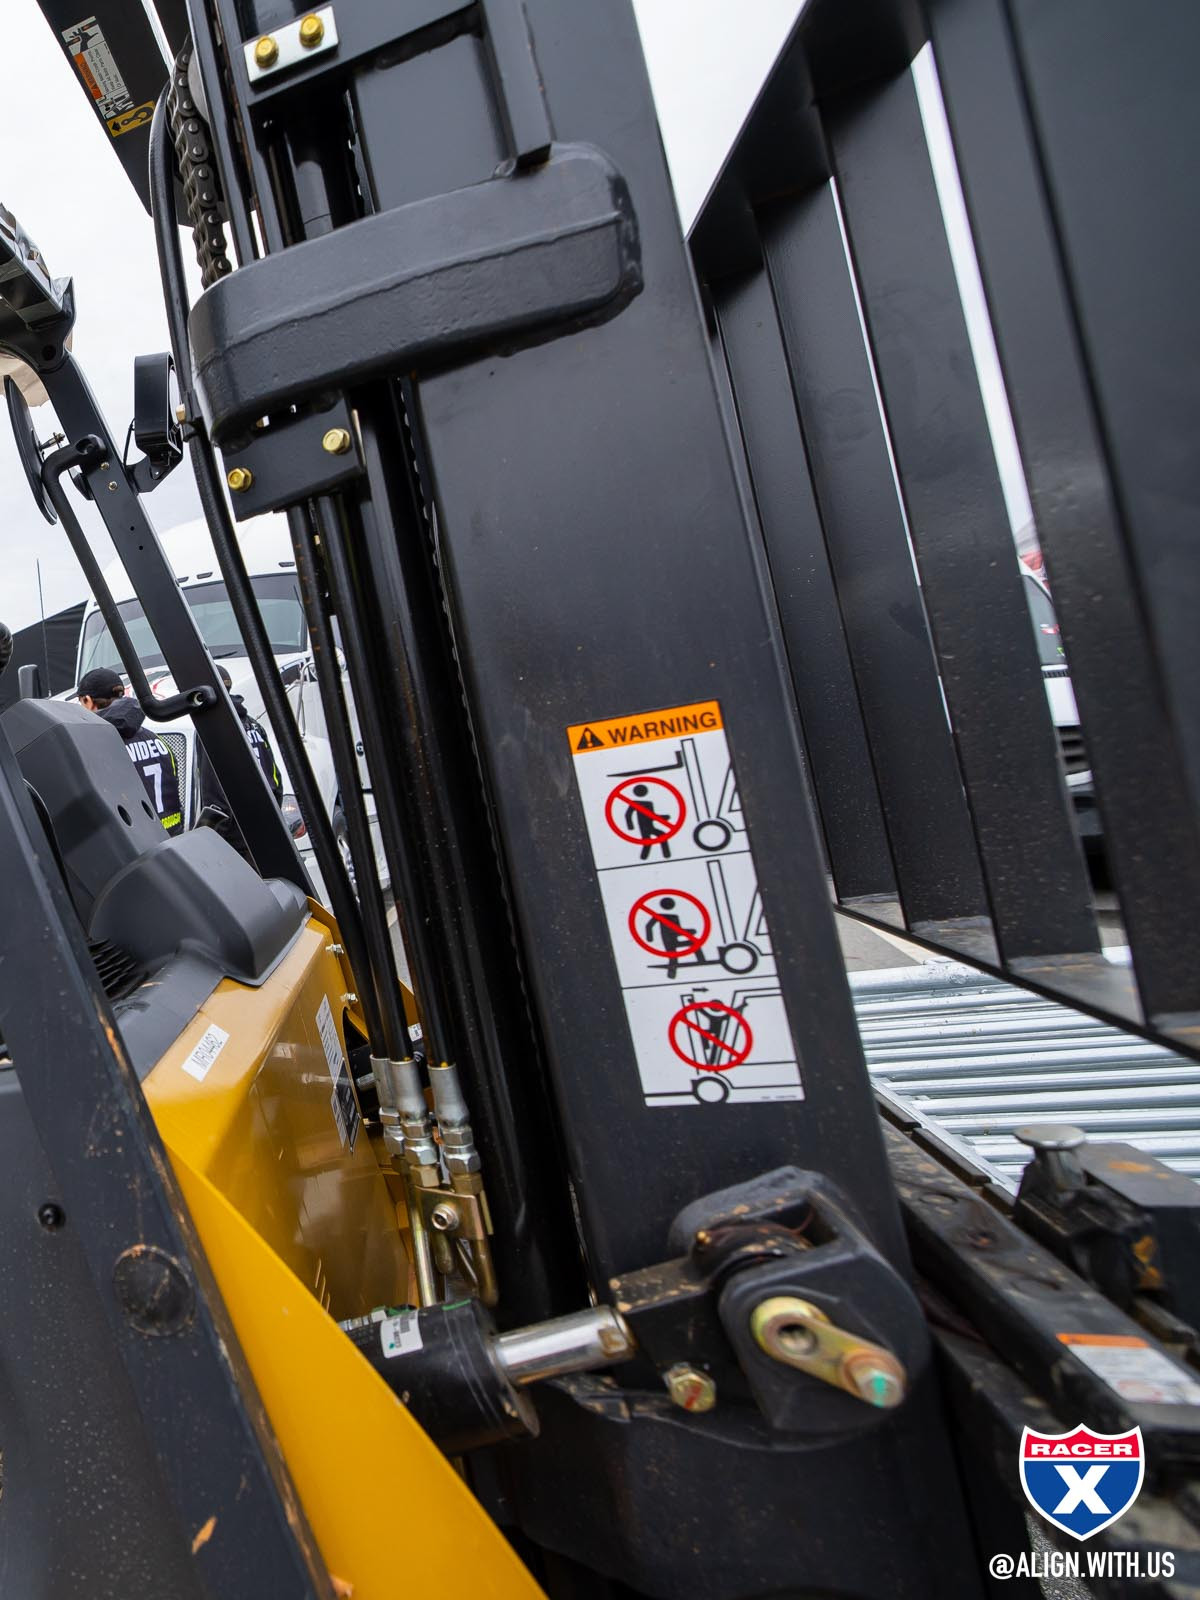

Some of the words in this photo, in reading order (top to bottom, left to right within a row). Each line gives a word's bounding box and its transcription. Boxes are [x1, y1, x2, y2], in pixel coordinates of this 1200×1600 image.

[608, 712, 717, 744] WARNING
[126, 738, 169, 762] VIDEO
[142, 763, 164, 814] 7
